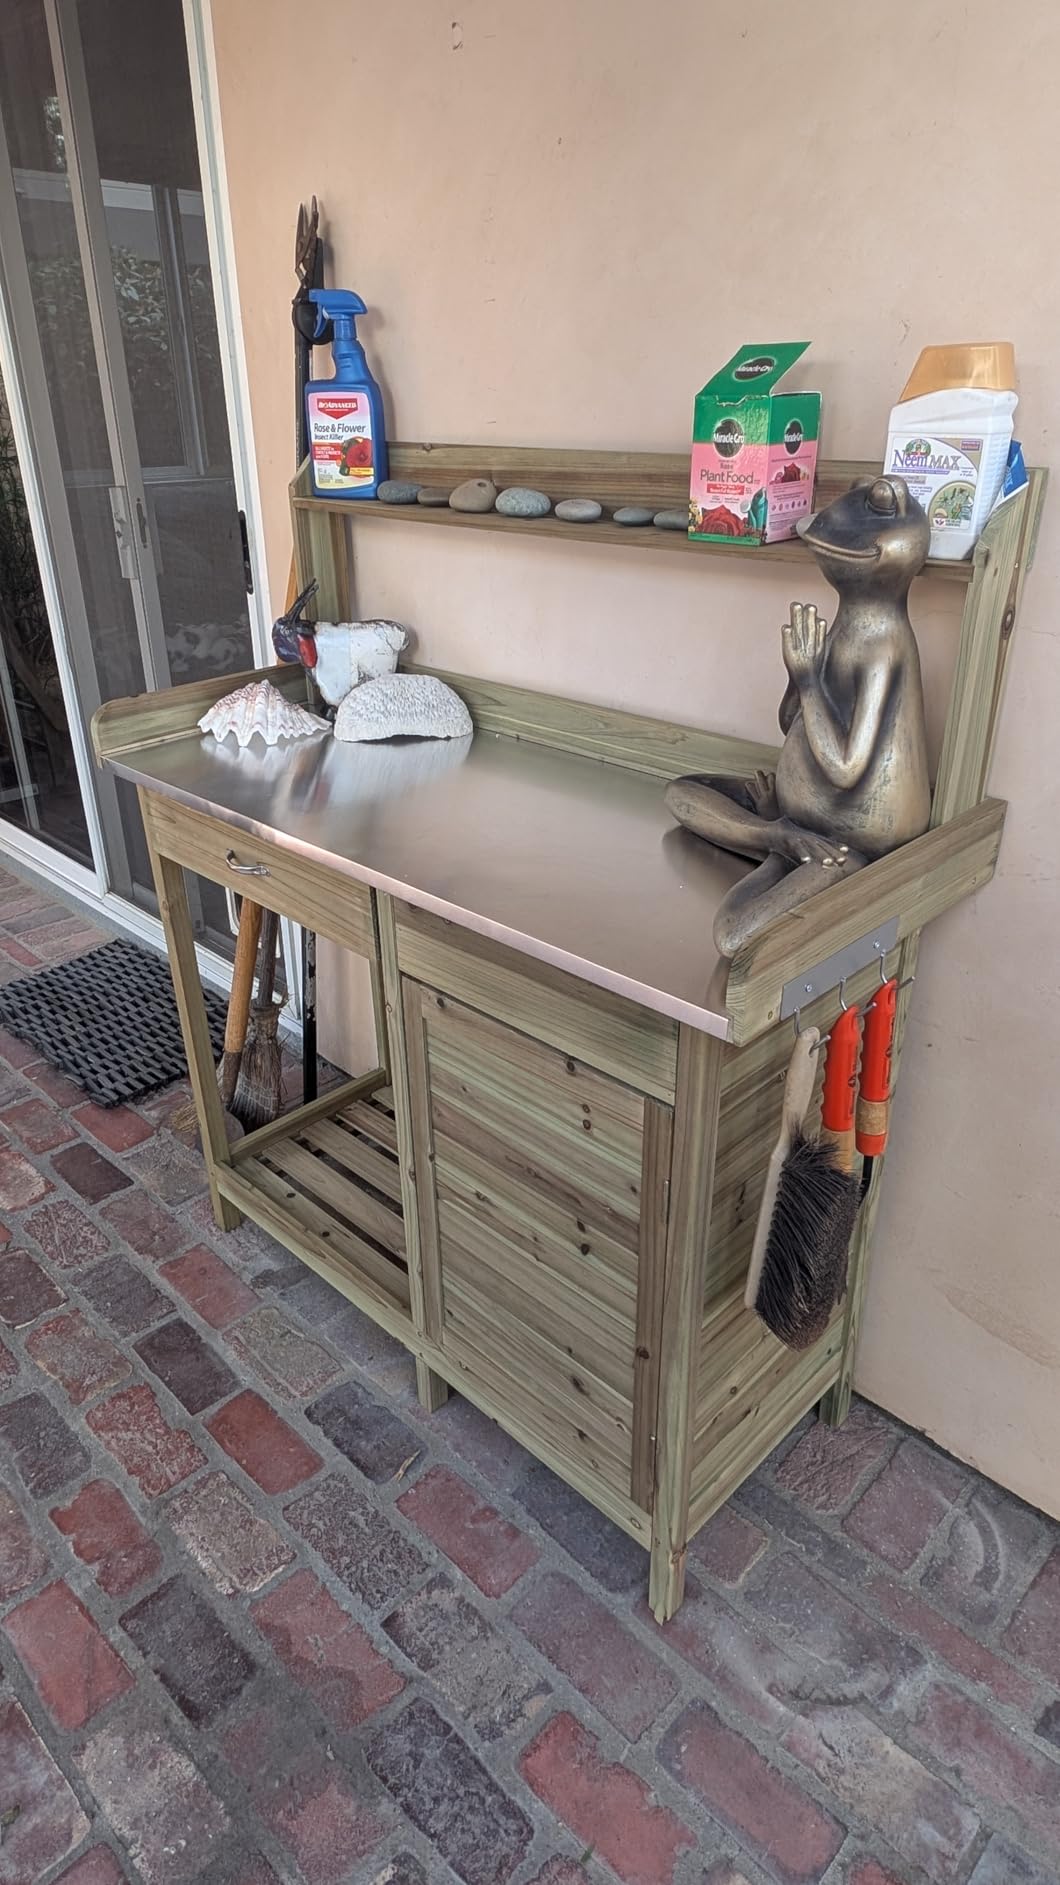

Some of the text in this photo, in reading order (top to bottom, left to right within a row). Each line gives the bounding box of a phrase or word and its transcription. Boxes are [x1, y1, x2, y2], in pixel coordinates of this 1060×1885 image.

[314, 423, 366, 432] Rose & Flower
[893, 449, 927, 467] Neem
[928, 455, 961, 471] MAX
[700, 468, 754, 484] Plant Food
